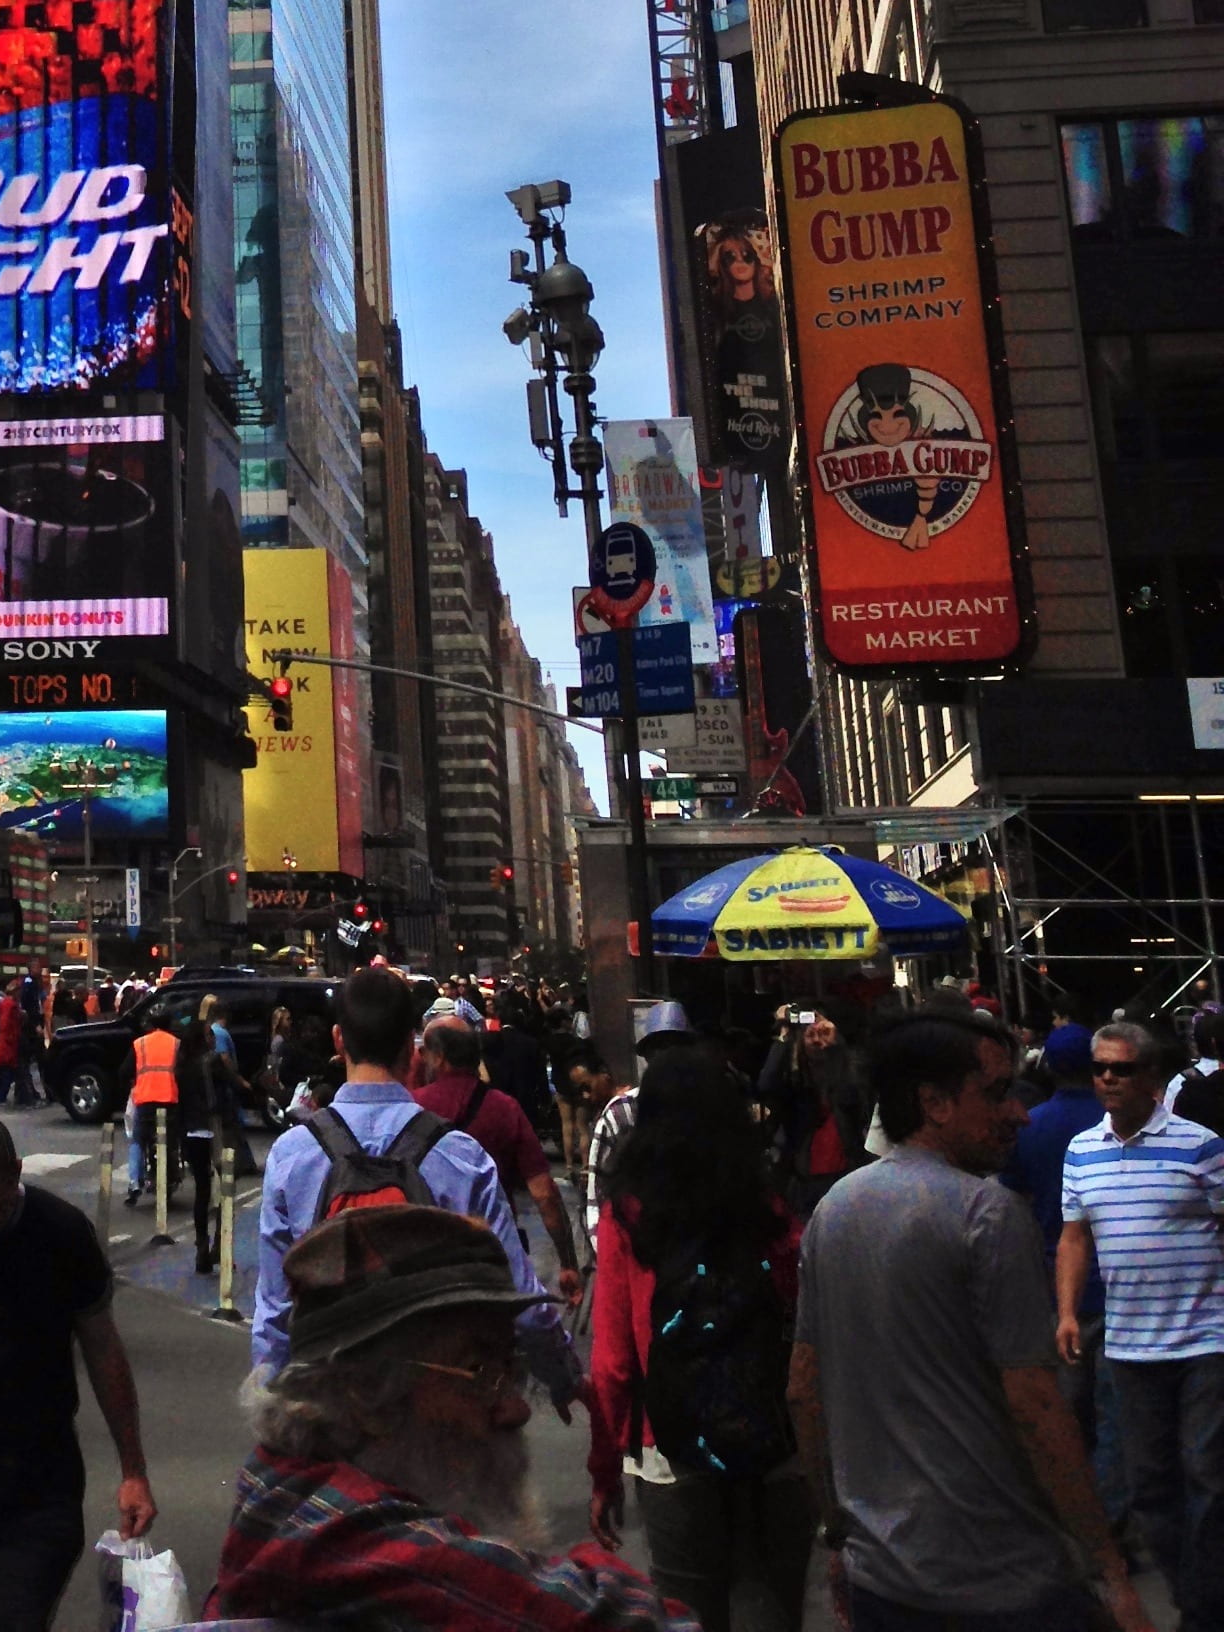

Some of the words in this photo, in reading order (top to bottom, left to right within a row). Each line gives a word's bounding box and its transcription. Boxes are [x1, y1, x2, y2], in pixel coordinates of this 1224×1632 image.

[791, 137, 958, 200] BUBBA
[810, 204, 952, 265] GUMP
[828, 276, 946, 304] SHRIMP
[815, 299, 965, 330] COMPANY
[33, 425, 93, 439] CENTURY
[94, 423, 120, 436] FOX
[728, 418, 754, 433] Hard
[755, 420, 780, 438] Rock
[823, 447, 909, 488] BUBBA
[913, 442, 989, 475] GUMP
[853, 480, 913, 500] SHRIMP
[59, 609, 124, 626] DONUTS
[831, 596, 1009, 622] RESTAURANT
[246, 618, 306, 635] TAKE
[4, 640, 100, 661] SONY
[581, 636, 601, 657] M7
[865, 627, 980, 651] MARKET
[583, 663, 615, 685] M20
[659, 657, 675, 667] Park
[9, 674, 68, 705] TOPS
[81, 673, 116, 703] NO.
[584, 690, 620, 713] M104
[715, 705, 729, 715] ST
[656, 780, 678, 798] 44
[713, 782, 732, 790] WAY
[129, 871, 138, 925] NYPD
[747, 877, 840, 902] SABRETT
[725, 925, 869, 953] SABRETT
